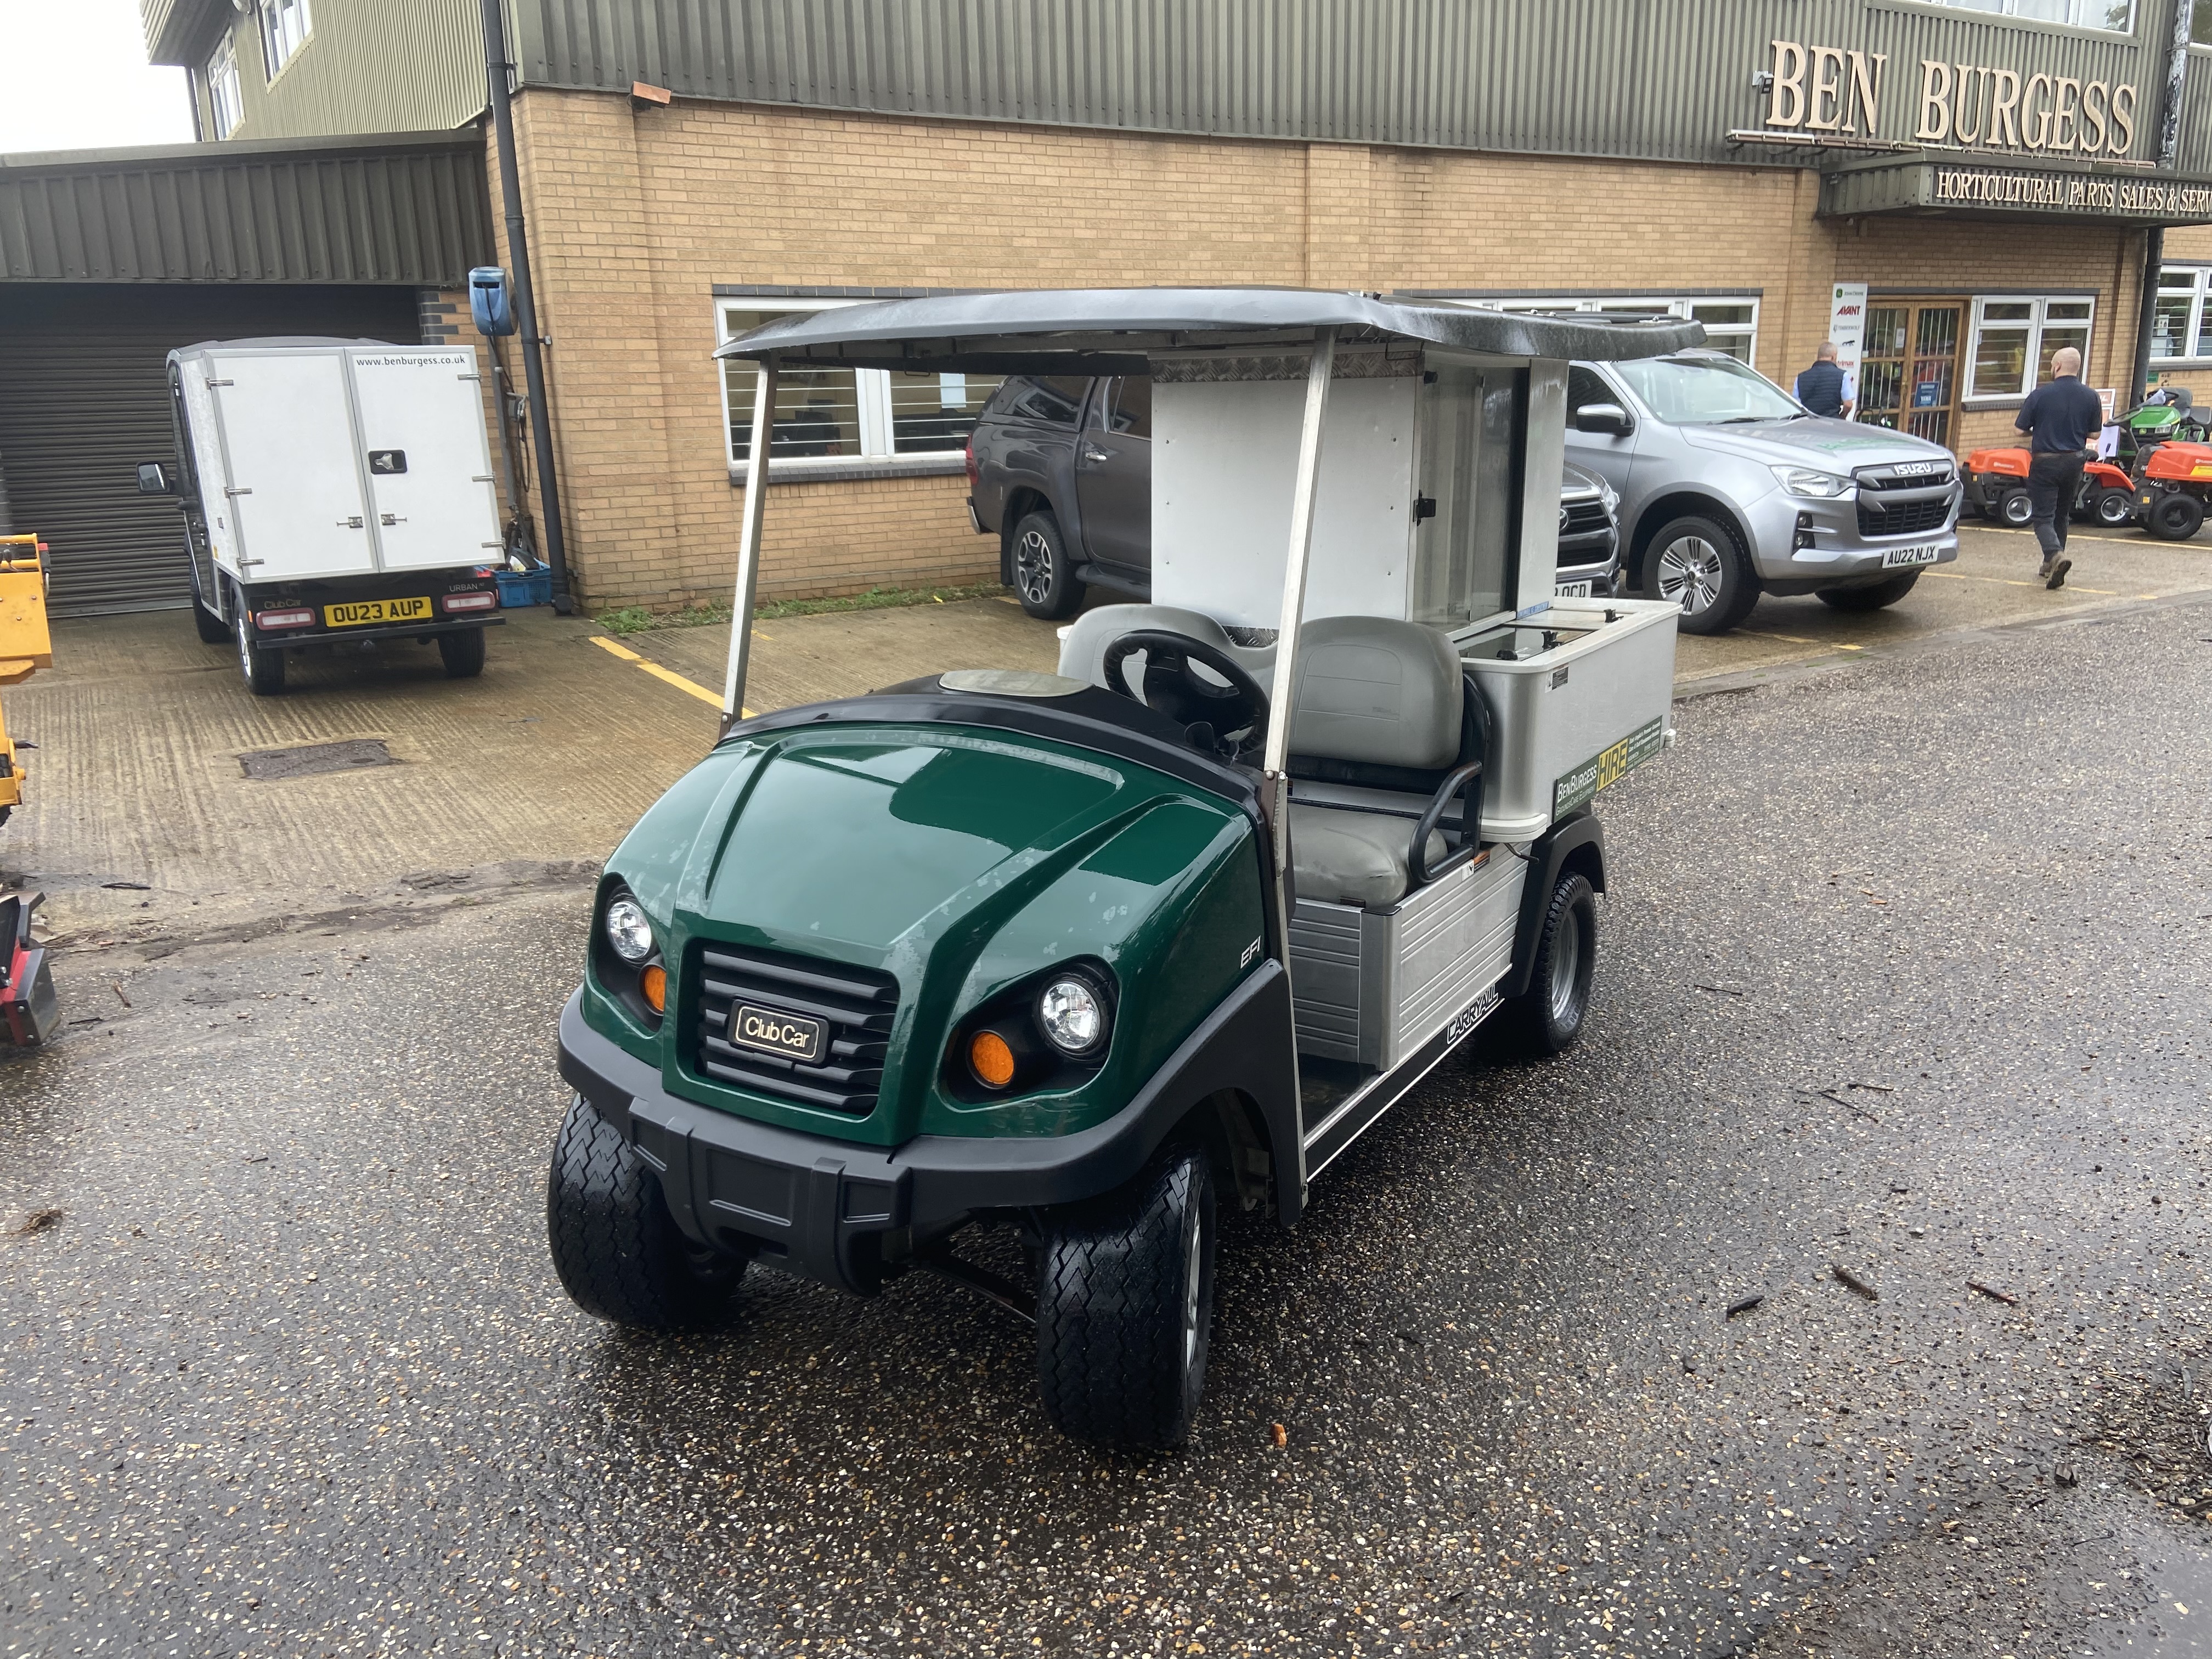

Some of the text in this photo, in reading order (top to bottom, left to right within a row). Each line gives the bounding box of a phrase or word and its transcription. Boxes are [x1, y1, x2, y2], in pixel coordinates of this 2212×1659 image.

[1765, 40, 2137, 155] BEN BURGESS
[1936, 171, 2063, 205] HORTICULTURAL
[2119, 185, 2164, 211] SALES
[2166, 188, 2177, 212] &
[1836, 305, 1861, 316] AVANT
[356, 355, 466, 367] www.benburgess.co.uk
[1893, 462, 1932, 476] ISUZU
[1887, 545, 1936, 565] AU22 NJX
[449, 583, 478, 592] URBAN
[264, 599, 302, 610] Club Car
[332, 600, 424, 623] OU23 AUP
[1598, 742, 1627, 789] HIRE
[1240, 935, 1261, 969] EFI
[1447, 983, 1499, 1045] CARRYALL
[746, 1016, 810, 1048] Club Car
